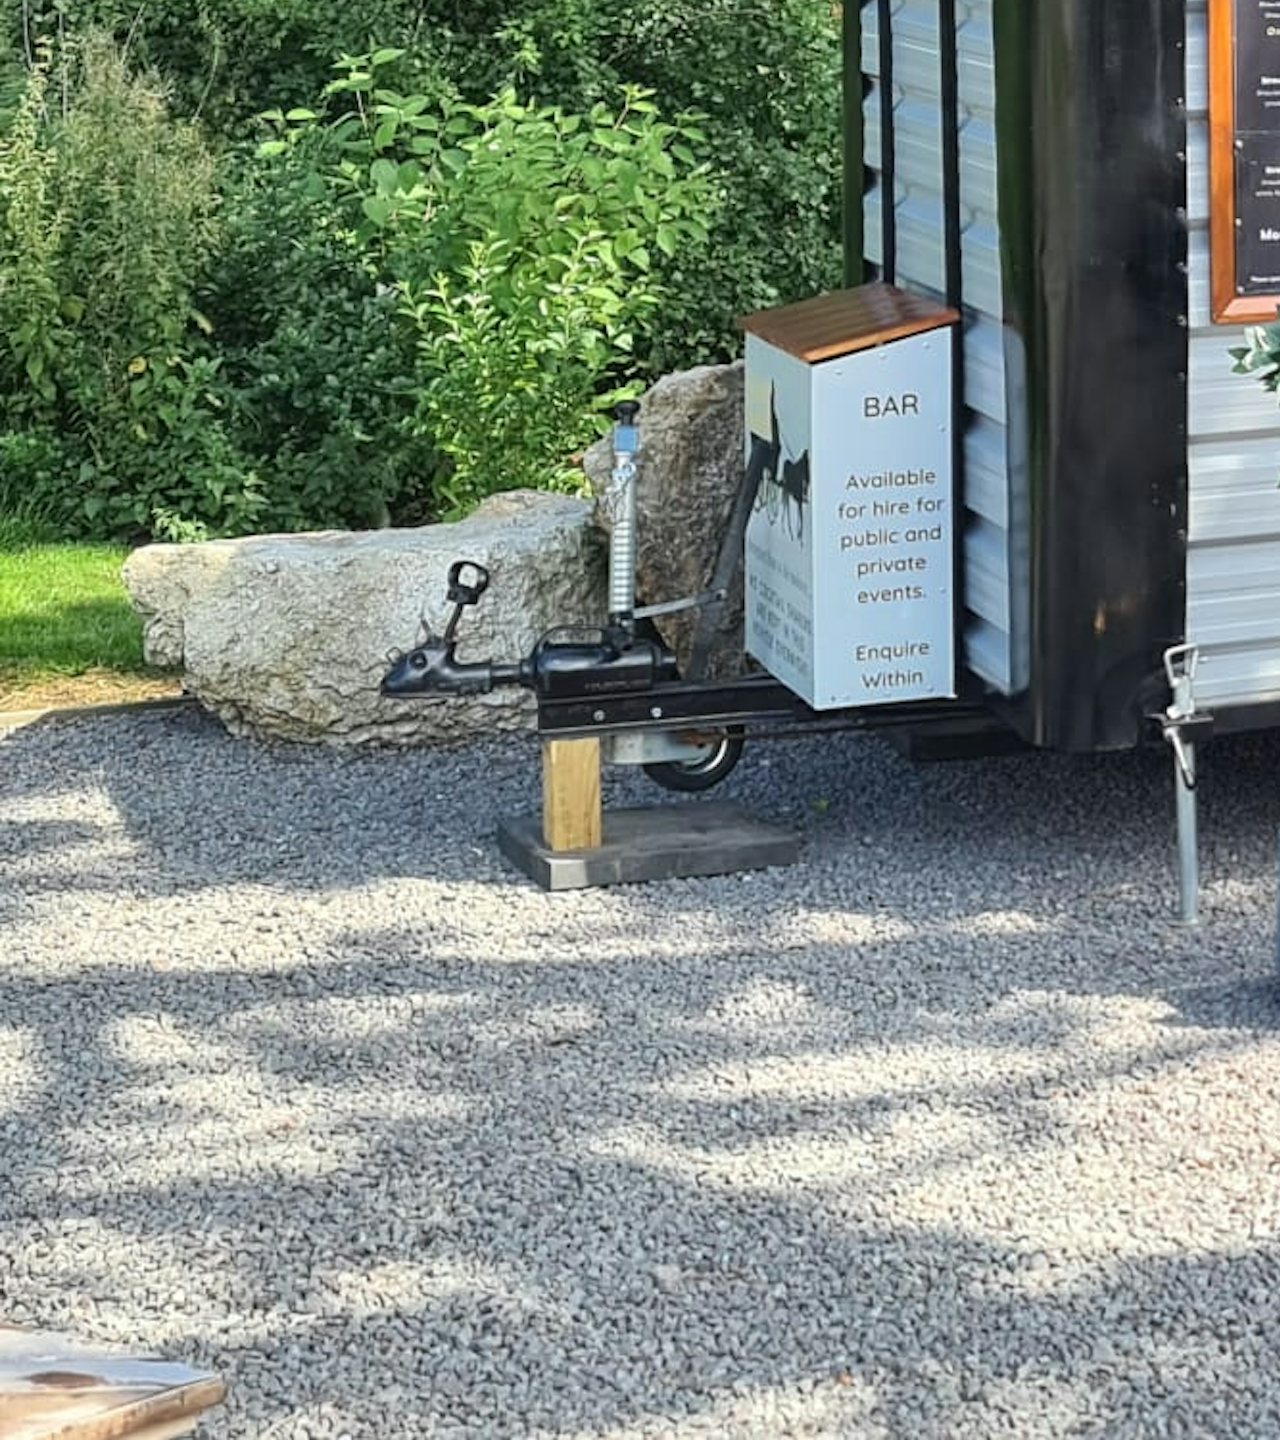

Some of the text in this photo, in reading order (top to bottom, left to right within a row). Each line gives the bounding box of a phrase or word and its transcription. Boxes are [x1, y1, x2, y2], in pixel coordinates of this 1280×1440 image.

[863, 394, 919, 418] BAR
[845, 468, 937, 490] Available
[838, 495, 945, 519] for hire for
[840, 525, 942, 552] public and
[856, 554, 928, 579] private
[857, 583, 928, 604] events.
[856, 639, 930, 665] Enquire
[862, 668, 924, 690] Within
